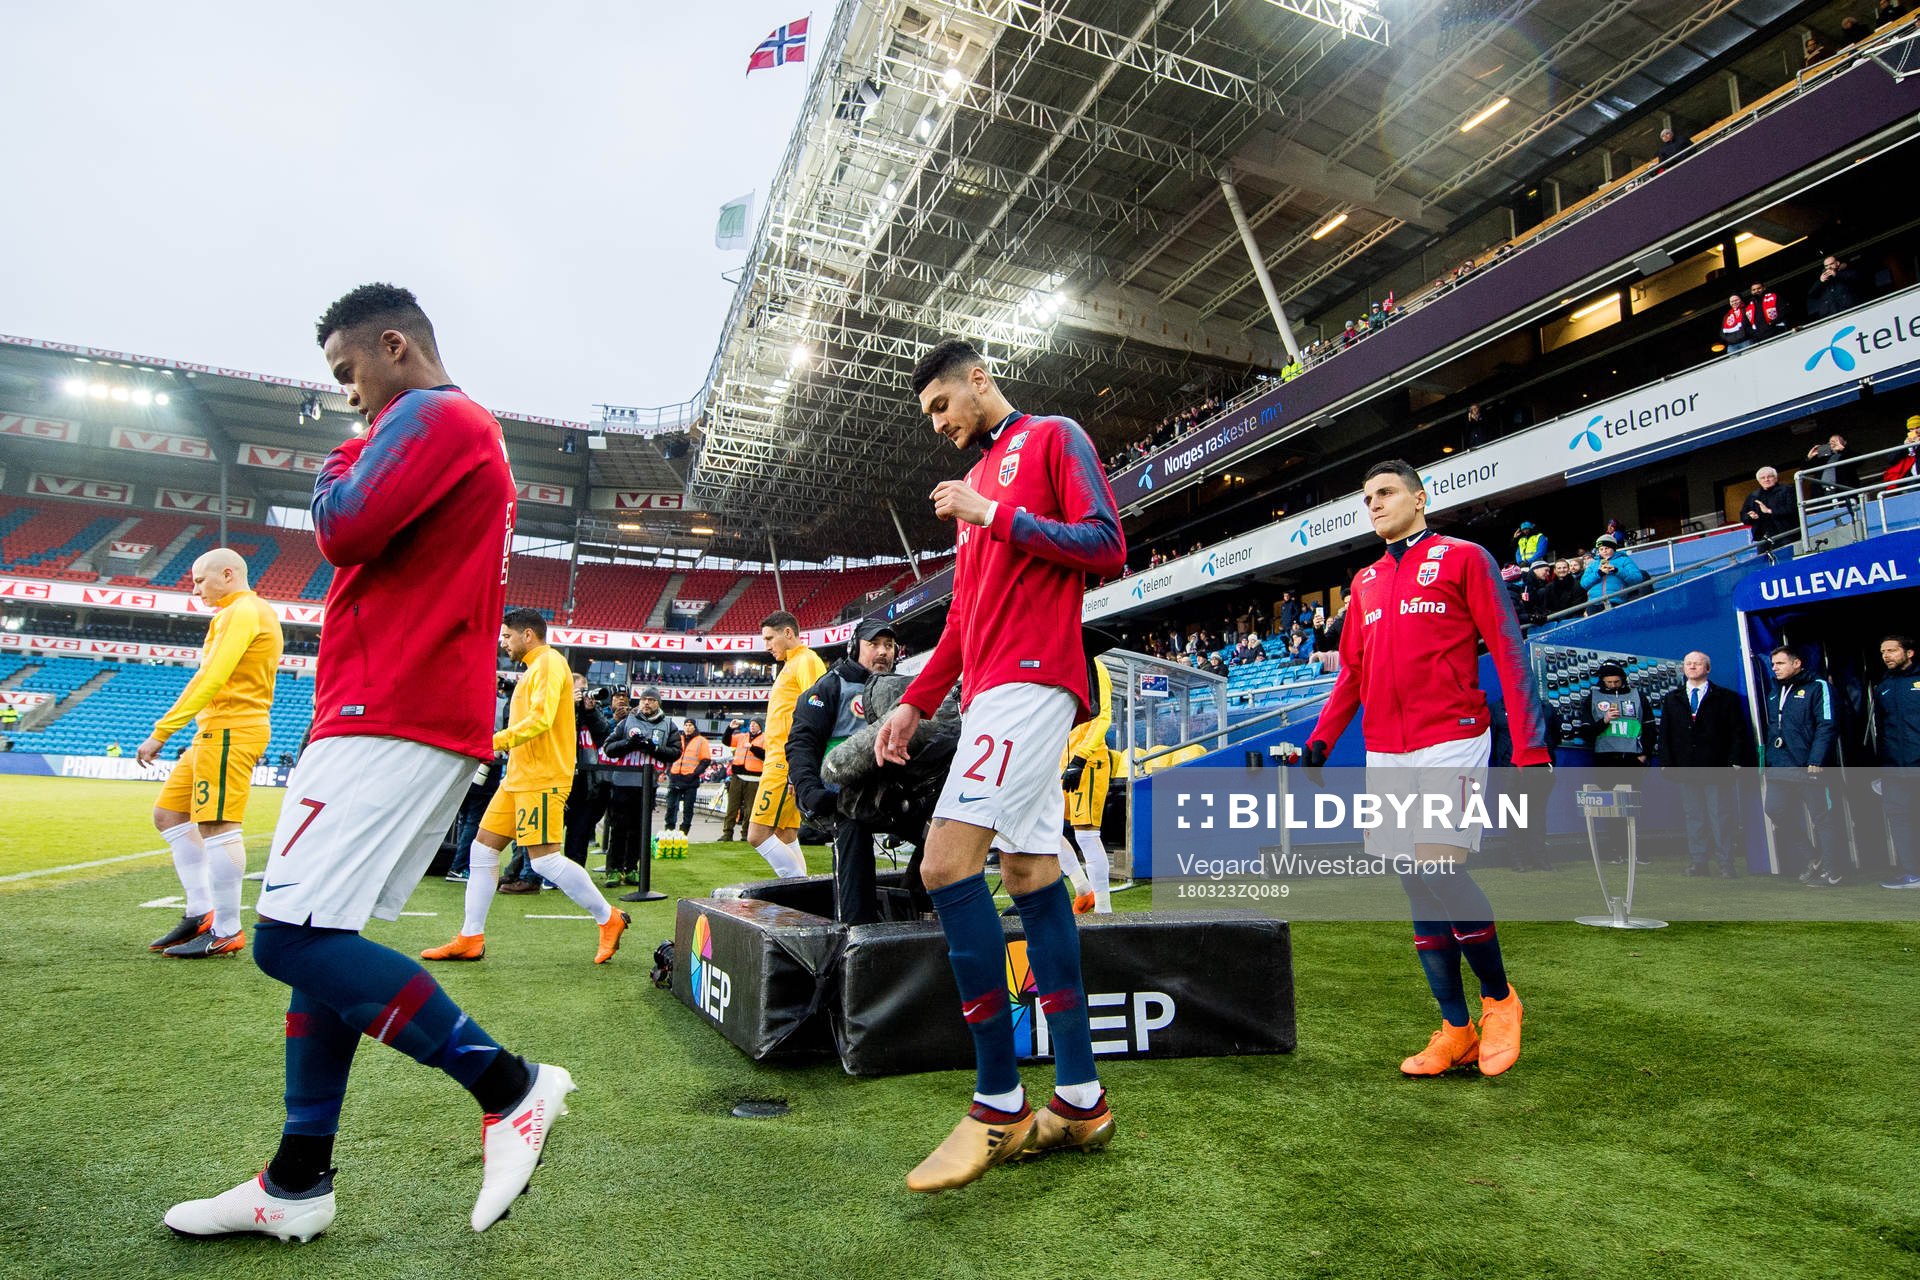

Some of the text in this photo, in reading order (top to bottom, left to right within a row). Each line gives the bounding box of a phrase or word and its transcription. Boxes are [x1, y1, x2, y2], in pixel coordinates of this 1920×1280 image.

[1603, 391, 1699, 439] telenor
[119, 430, 208, 459] VG
[1164, 443, 1203, 476] Norges
[1206, 416, 1257, 454] raskeste
[1432, 459, 1499, 496] telenor
[34, 475, 128, 502] VG
[161, 489, 249, 516] VG
[615, 492, 684, 509] VG
[1309, 509, 1358, 538] telenor
[1215, 545, 1253, 569] telenor
[1143, 574, 1173, 593] telenor
[1760, 559, 1907, 601] ULLEVAAL
[83, 588, 156, 608] VG
[674, 601, 706, 611] VG
[1085, 596, 1109, 613] telenor
[285, 607, 322, 623] V
[552, 631, 608, 646] VG
[632, 635, 685, 649] VG
[824, 624, 851, 643] VG
[31, 637, 80, 650] VG
[91, 642, 140, 655] VG
[149, 647, 196, 659] VG
[706, 637, 753, 650] VG
[676, 689, 712, 699] VG
[715, 689, 750, 700] VG
[753, 690, 771, 699] V
[1609, 720, 1628, 735] TV
[962, 733, 1014, 788] 21
[760, 790, 772, 811] 5
[1075, 792, 1083, 811] 7
[281, 797, 327, 857] 7
[517, 806, 538, 830] 24
[700, 960, 731, 1024] NEP
[532, 1098, 544, 1152] adidas
